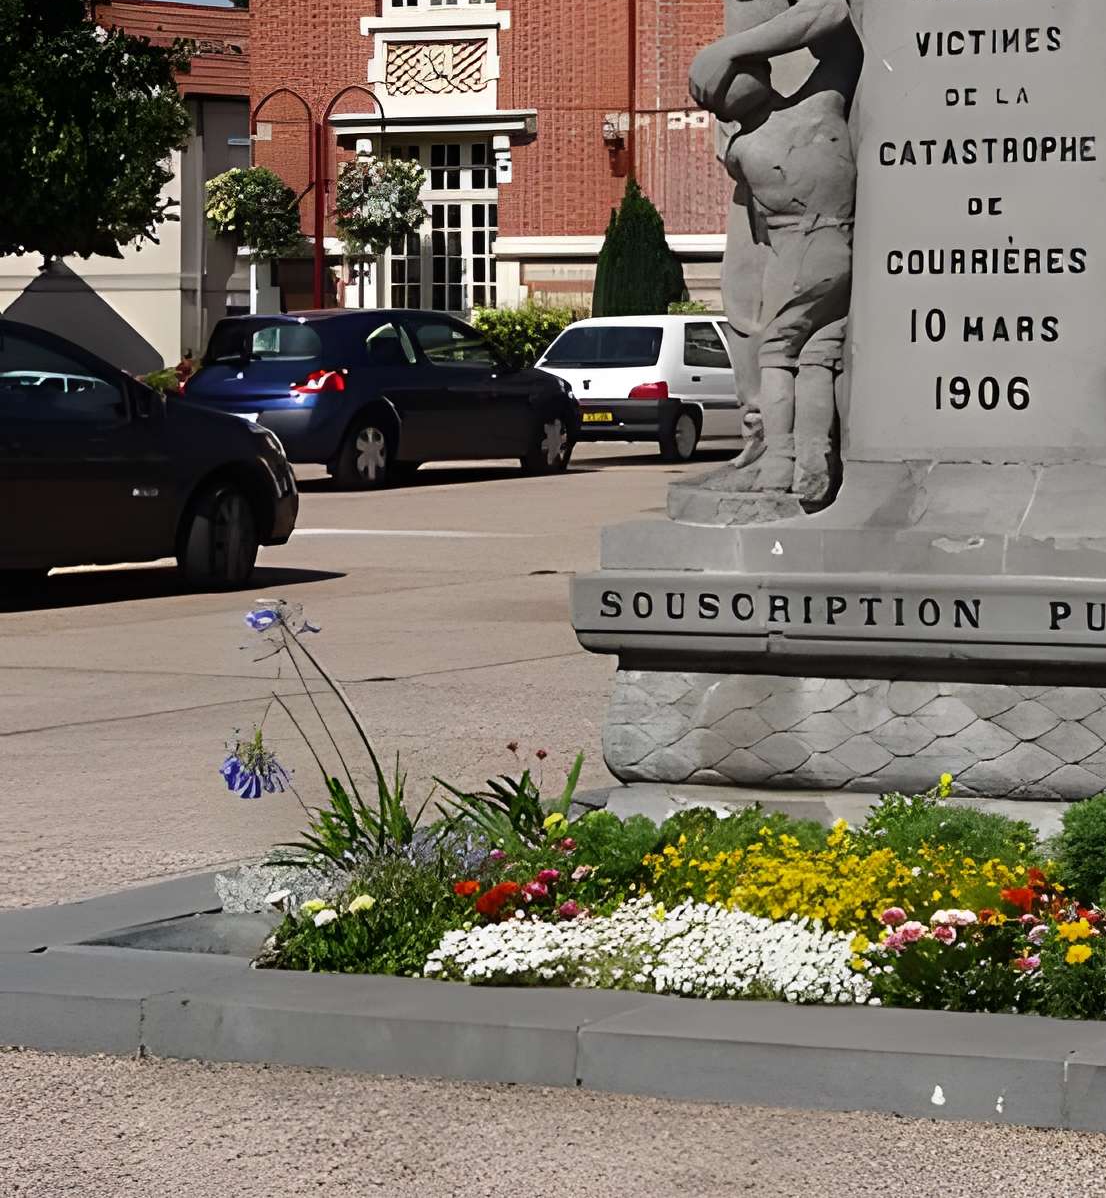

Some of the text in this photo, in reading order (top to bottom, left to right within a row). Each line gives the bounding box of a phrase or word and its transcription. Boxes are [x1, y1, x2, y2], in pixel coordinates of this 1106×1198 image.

[916, 26, 1061, 57] VICTIMES
[946, 87, 1029, 106] DE LA
[880, 136, 1096, 166] CATASTROPHE
[968, 197, 1002, 215] DE
[887, 236, 1087, 274] COURRIÈRES
[911, 308, 1059, 342] 10 MARS
[935, 376, 1030, 410] 1906
[600, 590, 981, 630] SOUSCRIPTION
